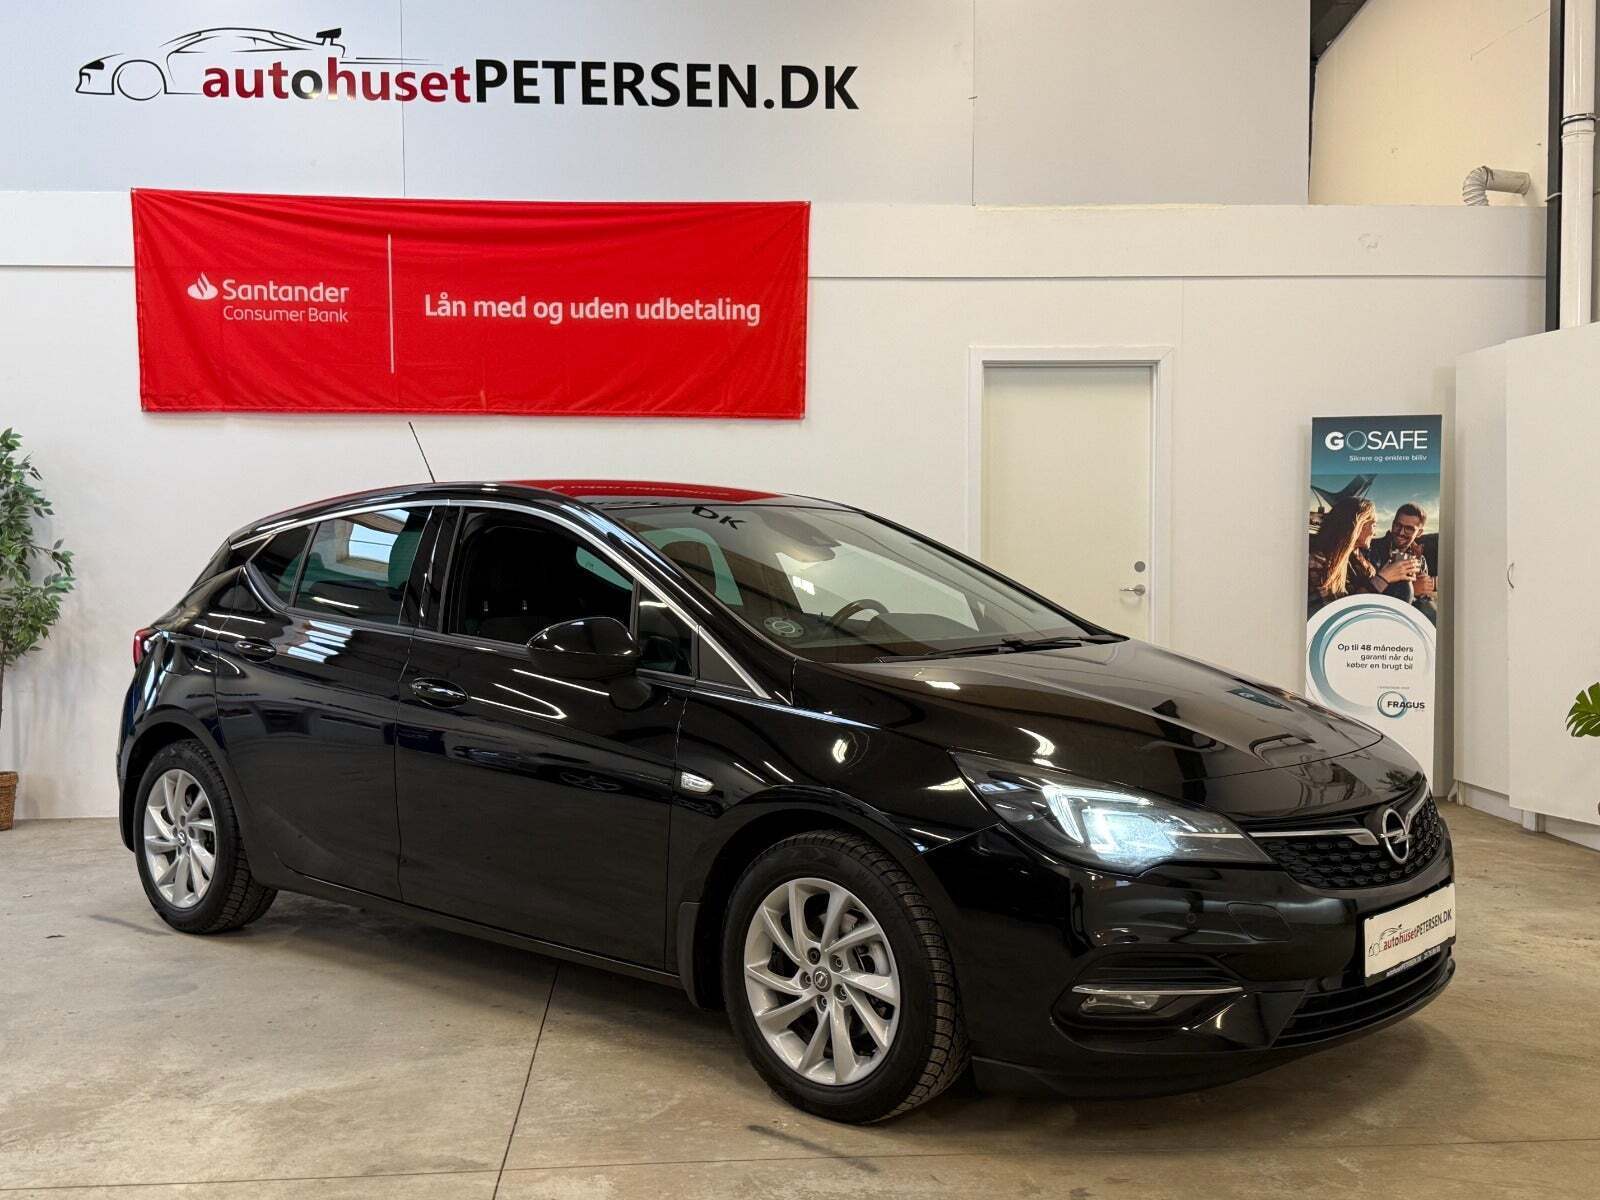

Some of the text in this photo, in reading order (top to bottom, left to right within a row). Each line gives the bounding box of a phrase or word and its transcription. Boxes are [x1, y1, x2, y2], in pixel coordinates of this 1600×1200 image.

[202, 56, 859, 110] autohusetPETERSEN.DK
[222, 278, 350, 304] Santander
[223, 306, 348, 323] Consumer Bank
[424, 291, 761, 327] Lån med og uden udbetaling
[1324, 430, 1428, 451] GOSAFE
[1337, 643, 1350, 652] Op
[1373, 644, 1414, 652] måneders
[1346, 660, 1368, 669] køber
[1381, 662, 1402, 671] brugt
[1403, 662, 1413, 670] bil
[1388, 653, 1401, 661] når
[1387, 700, 1425, 709] FRAGUS
